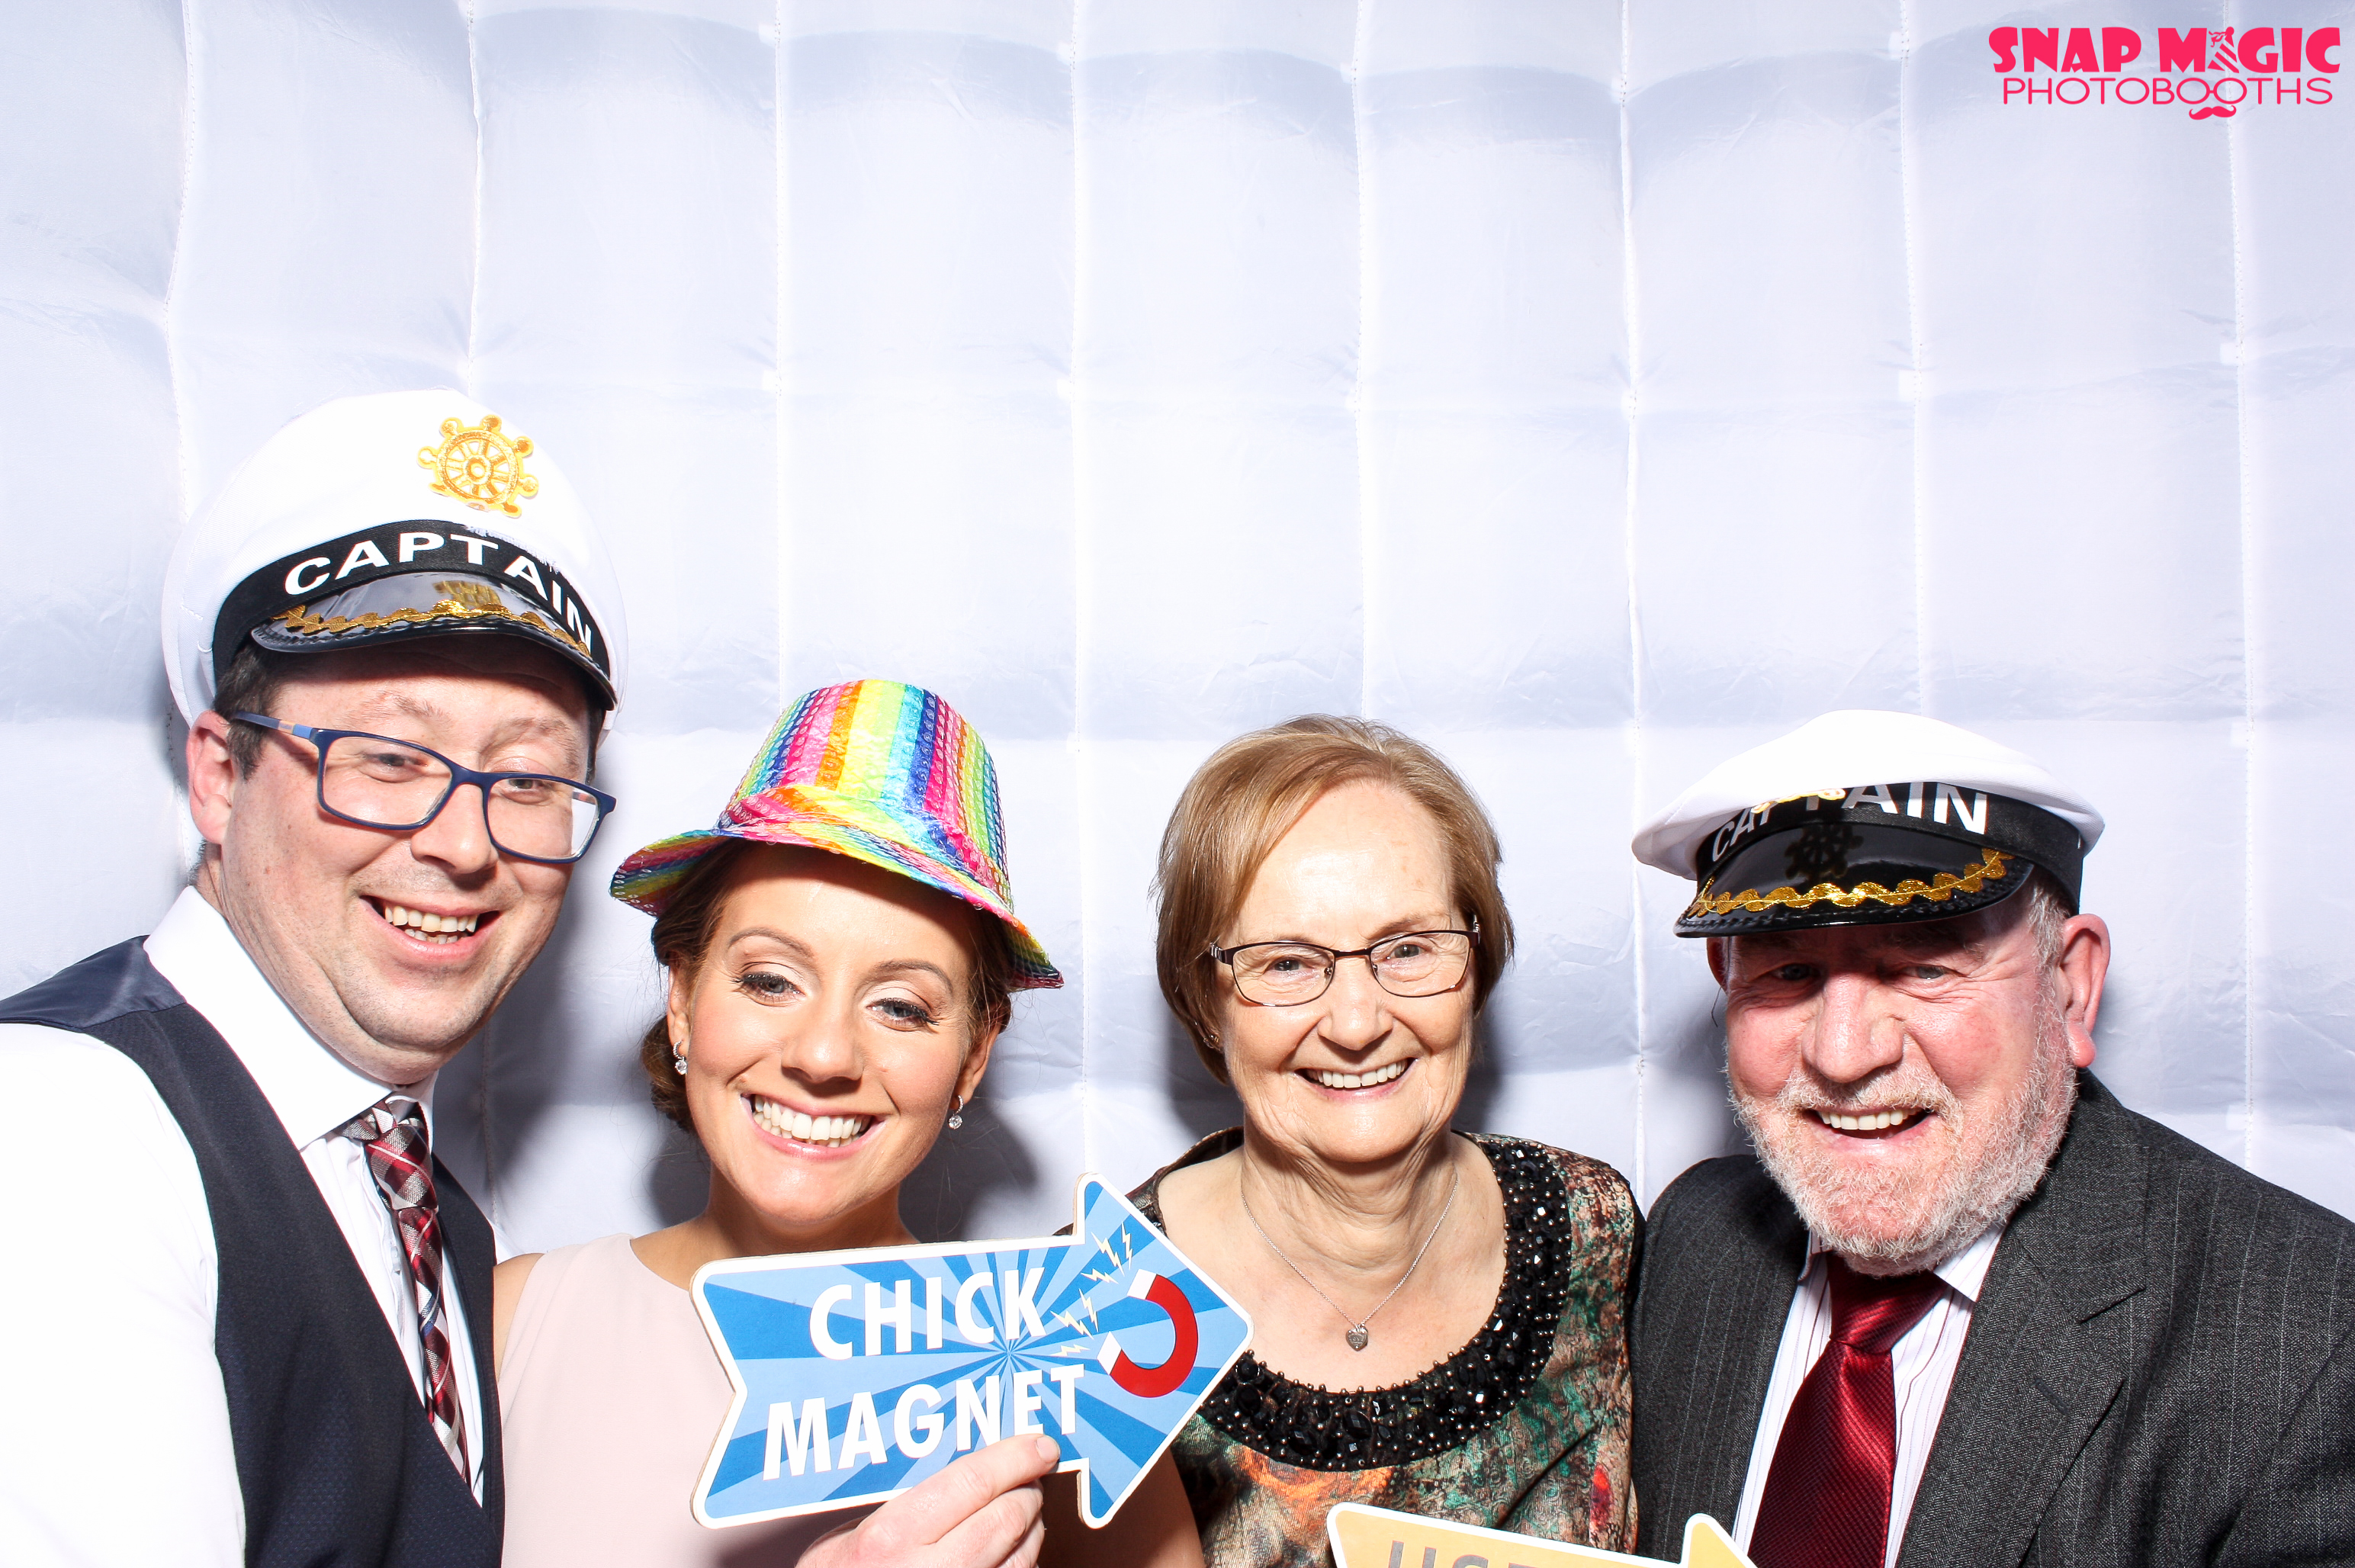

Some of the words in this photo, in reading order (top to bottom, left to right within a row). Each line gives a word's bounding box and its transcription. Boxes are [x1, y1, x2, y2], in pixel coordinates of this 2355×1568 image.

[283, 531, 593, 654] CAPTAIN
[808, 1266, 1049, 1361] CHICK
[763, 1363, 1084, 1480] MAGNET
